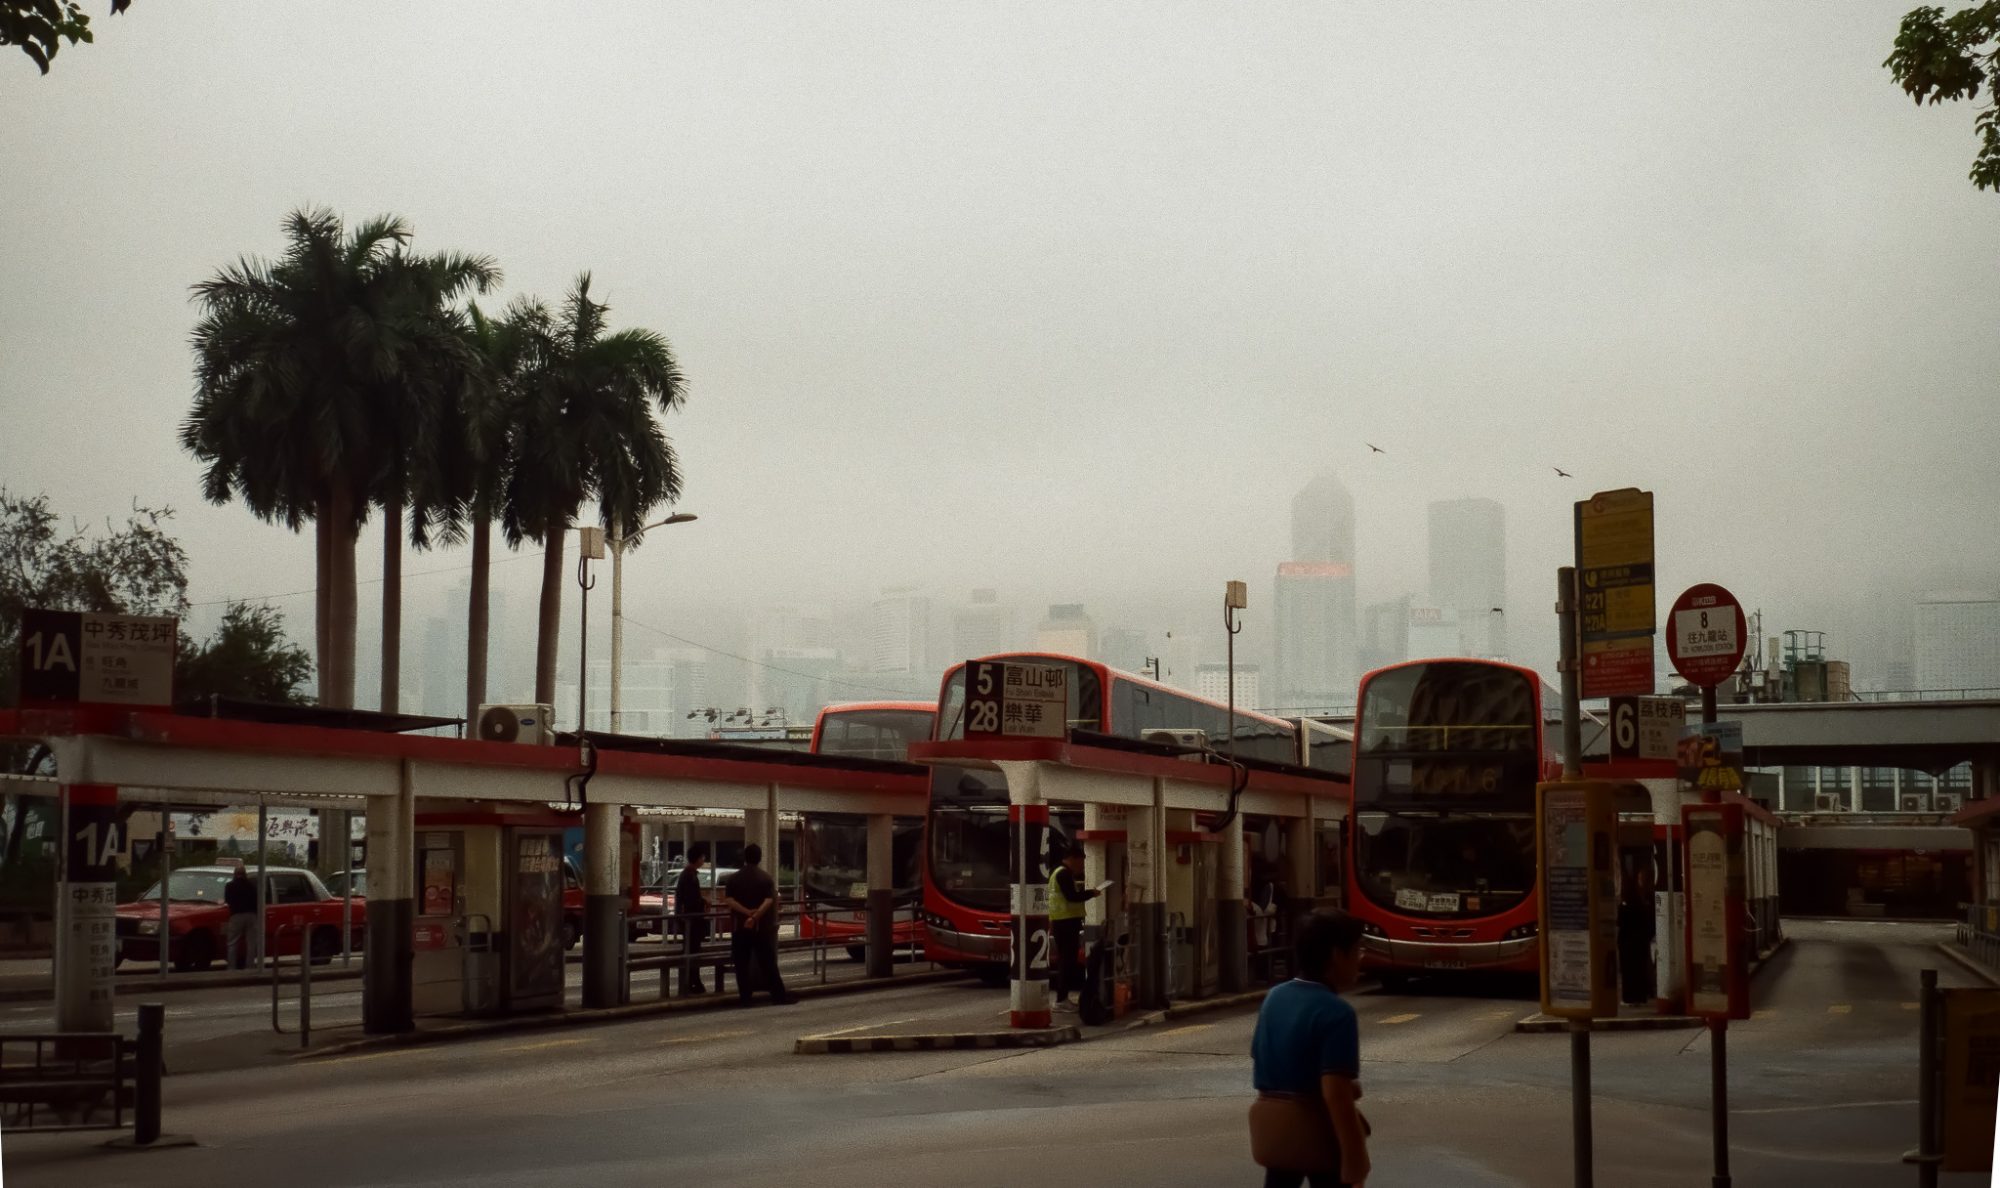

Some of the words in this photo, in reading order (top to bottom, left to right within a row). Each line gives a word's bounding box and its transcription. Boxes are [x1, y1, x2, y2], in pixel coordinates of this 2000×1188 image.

[84, 620, 173, 643] 中秀茂坪
[1700, 610, 1709, 629] 8
[25, 630, 77, 673] 1A
[976, 663, 993, 695] 5
[1006, 665, 1063, 688] 富山邨
[968, 699, 999, 733] 28
[1004, 702, 1043, 724] 樂華
[1639, 699, 1683, 719] 荔枝角
[1615, 703, 1636, 749] 6
[1480, 766, 1497, 793] 6
[75, 821, 119, 868] 1A
